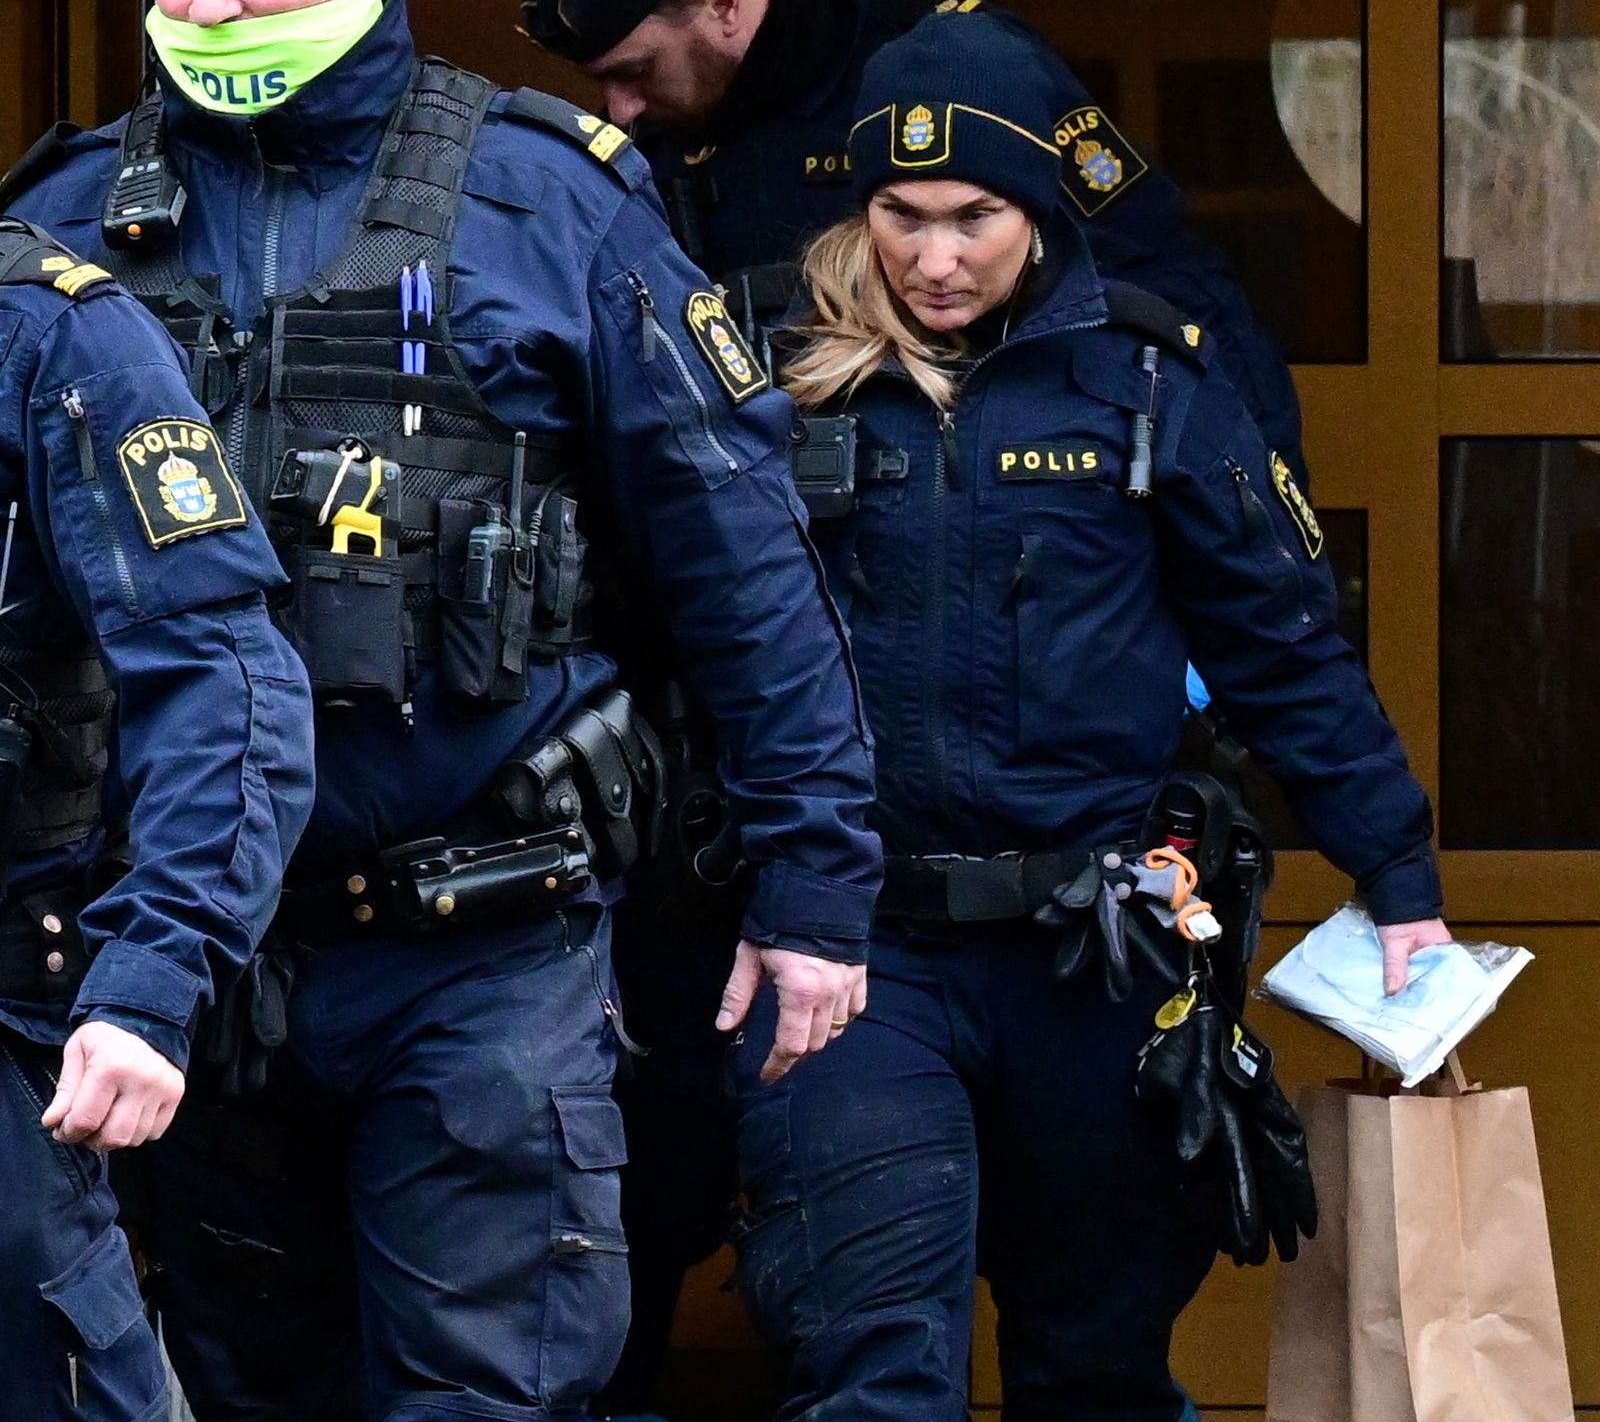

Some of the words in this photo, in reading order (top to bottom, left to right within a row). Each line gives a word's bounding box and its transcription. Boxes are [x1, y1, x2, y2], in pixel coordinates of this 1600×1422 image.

[179, 62, 288, 104] POLIS
[1055, 111, 1099, 147] OLIS
[805, 151, 853, 175] POL
[692, 298, 724, 333] POLIS
[125, 427, 209, 467] POLIS
[1000, 450, 1098, 472] POLIS
